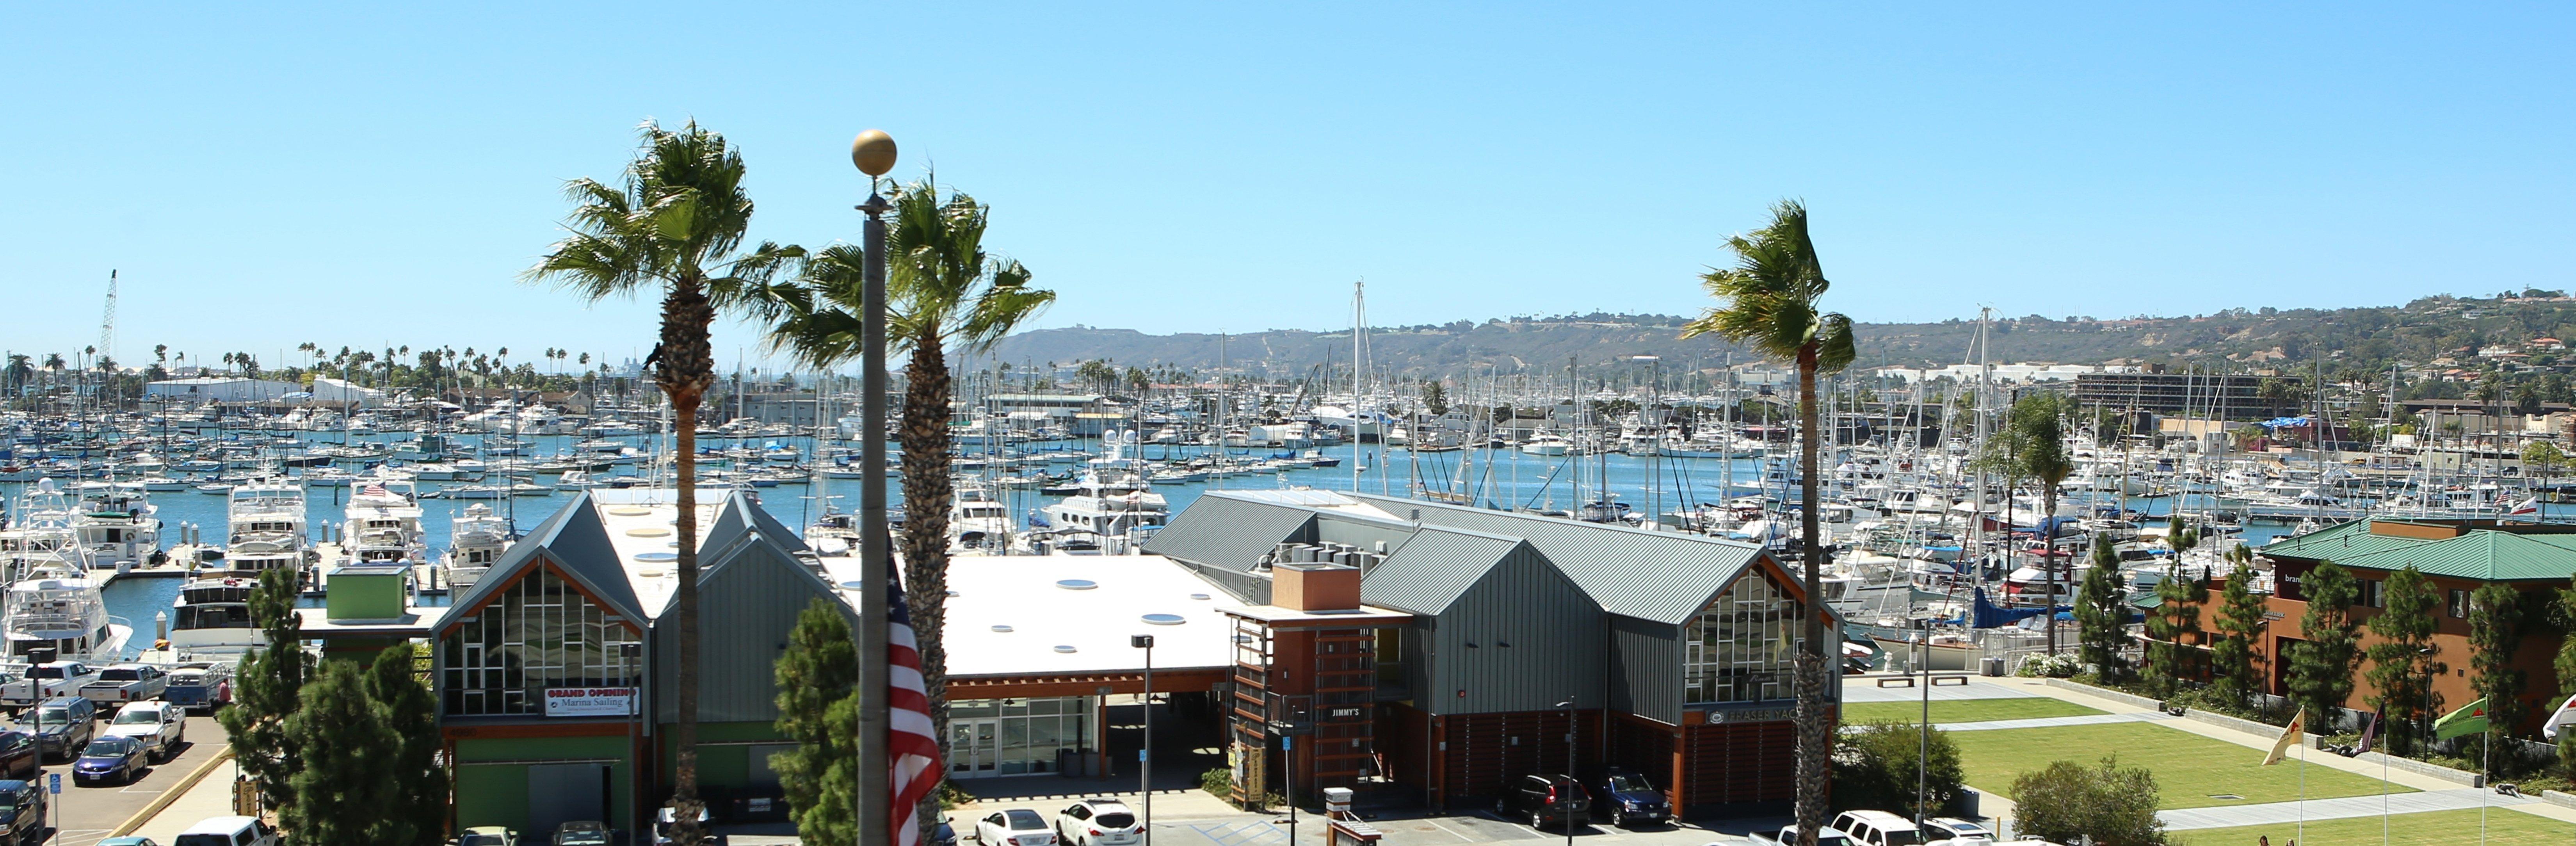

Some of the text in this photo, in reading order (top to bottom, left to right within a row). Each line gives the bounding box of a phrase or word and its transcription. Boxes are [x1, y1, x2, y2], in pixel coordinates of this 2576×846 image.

[548, 689, 585, 698] GRAND
[562, 697, 623, 707] Marina Sailing
[1332, 708, 1359, 717] JIMMY'S
[1729, 709, 1796, 721] FRASER YAC
